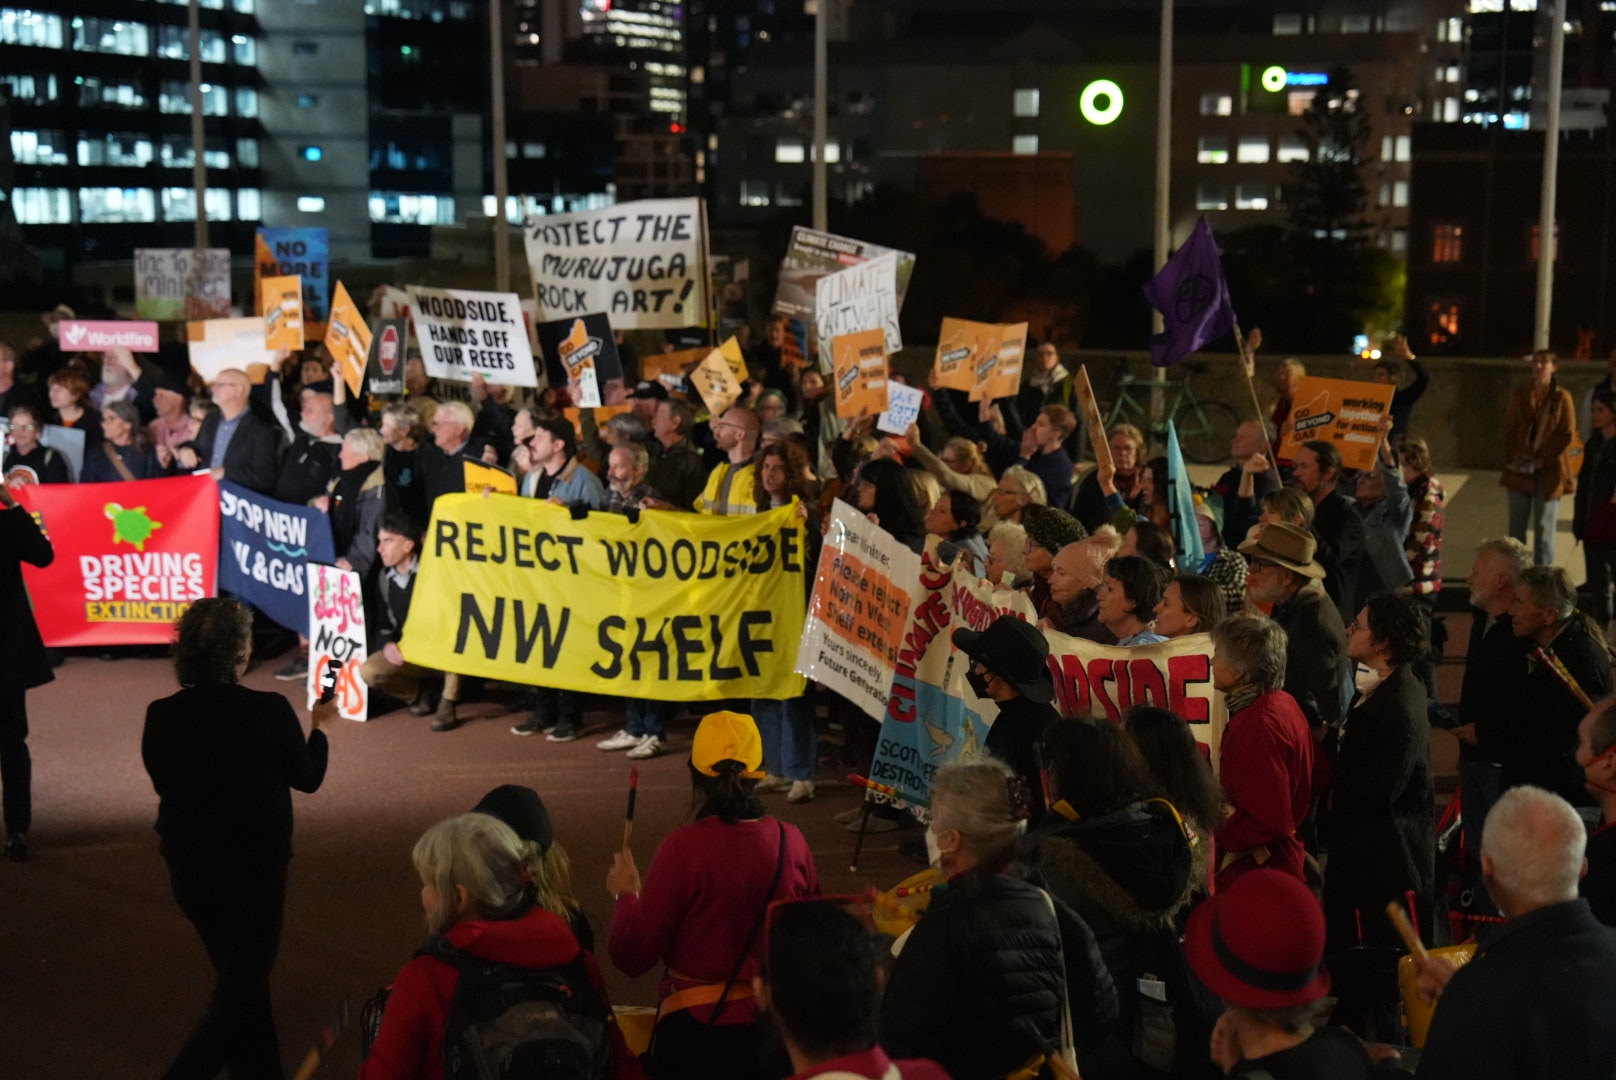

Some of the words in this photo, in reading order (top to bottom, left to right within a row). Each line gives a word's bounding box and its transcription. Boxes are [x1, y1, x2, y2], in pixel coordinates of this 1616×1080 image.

[636, 214, 691, 242] THE
[276, 242, 307, 256] NO
[260, 262, 322, 277] MORE
[542, 253, 687, 281] MURUJUGA
[415, 294, 515, 326] WOODSIDE,
[537, 283, 587, 312] ROCK
[611, 279, 694, 314] ART!
[429, 324, 478, 346] HANDS
[482, 330, 508, 348] OFF
[434, 345, 465, 366] OUR
[469, 349, 514, 370] REEFS
[1294, 408, 1310, 419] GO
[1342, 398, 1385, 412] working
[1294, 429, 1316, 442] GAS
[1296, 413, 1331, 431] BEYOND
[1336, 420, 1349, 430] for
[264, 508, 307, 547] NEW
[435, 519, 584, 575] REJECT
[600, 527, 801, 582] WOODSIDE
[79, 551, 203, 579] DRIVING
[252, 550, 269, 584] &
[268, 558, 304, 596] GAS
[83, 575, 206, 600] SPECIES
[85, 601, 191, 620] EXTINCTI
[315, 623, 363, 662] NOT
[453, 592, 571, 669] NW
[590, 610, 774, 682] SHELF
[823, 632, 845, 656] Yours
[846, 648, 883, 684] sinceely,
[818, 650, 848, 678] Future
[849, 669, 888, 706] Generatio
